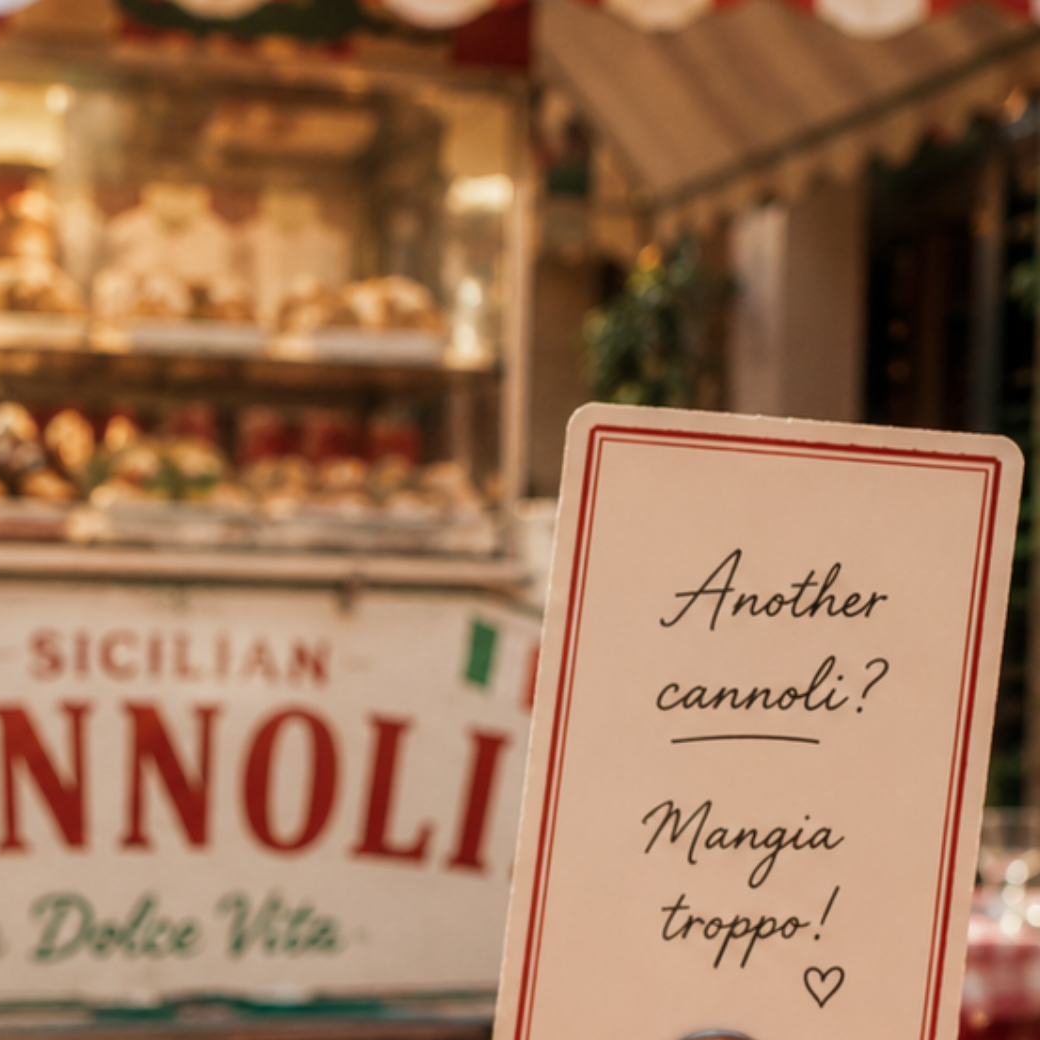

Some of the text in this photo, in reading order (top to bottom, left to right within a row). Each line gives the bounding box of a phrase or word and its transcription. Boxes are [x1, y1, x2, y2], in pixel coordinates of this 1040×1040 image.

[659, 548, 888, 631] Another
[28, 628, 331, 686] SICILIAN
[655, 655, 889, 714] cannoli?
[641, 800, 845, 889] Mangia
[30, 891, 199, 963] Dolce
[216, 890, 341, 960] Vita
[660, 884, 841, 969] troppo!
